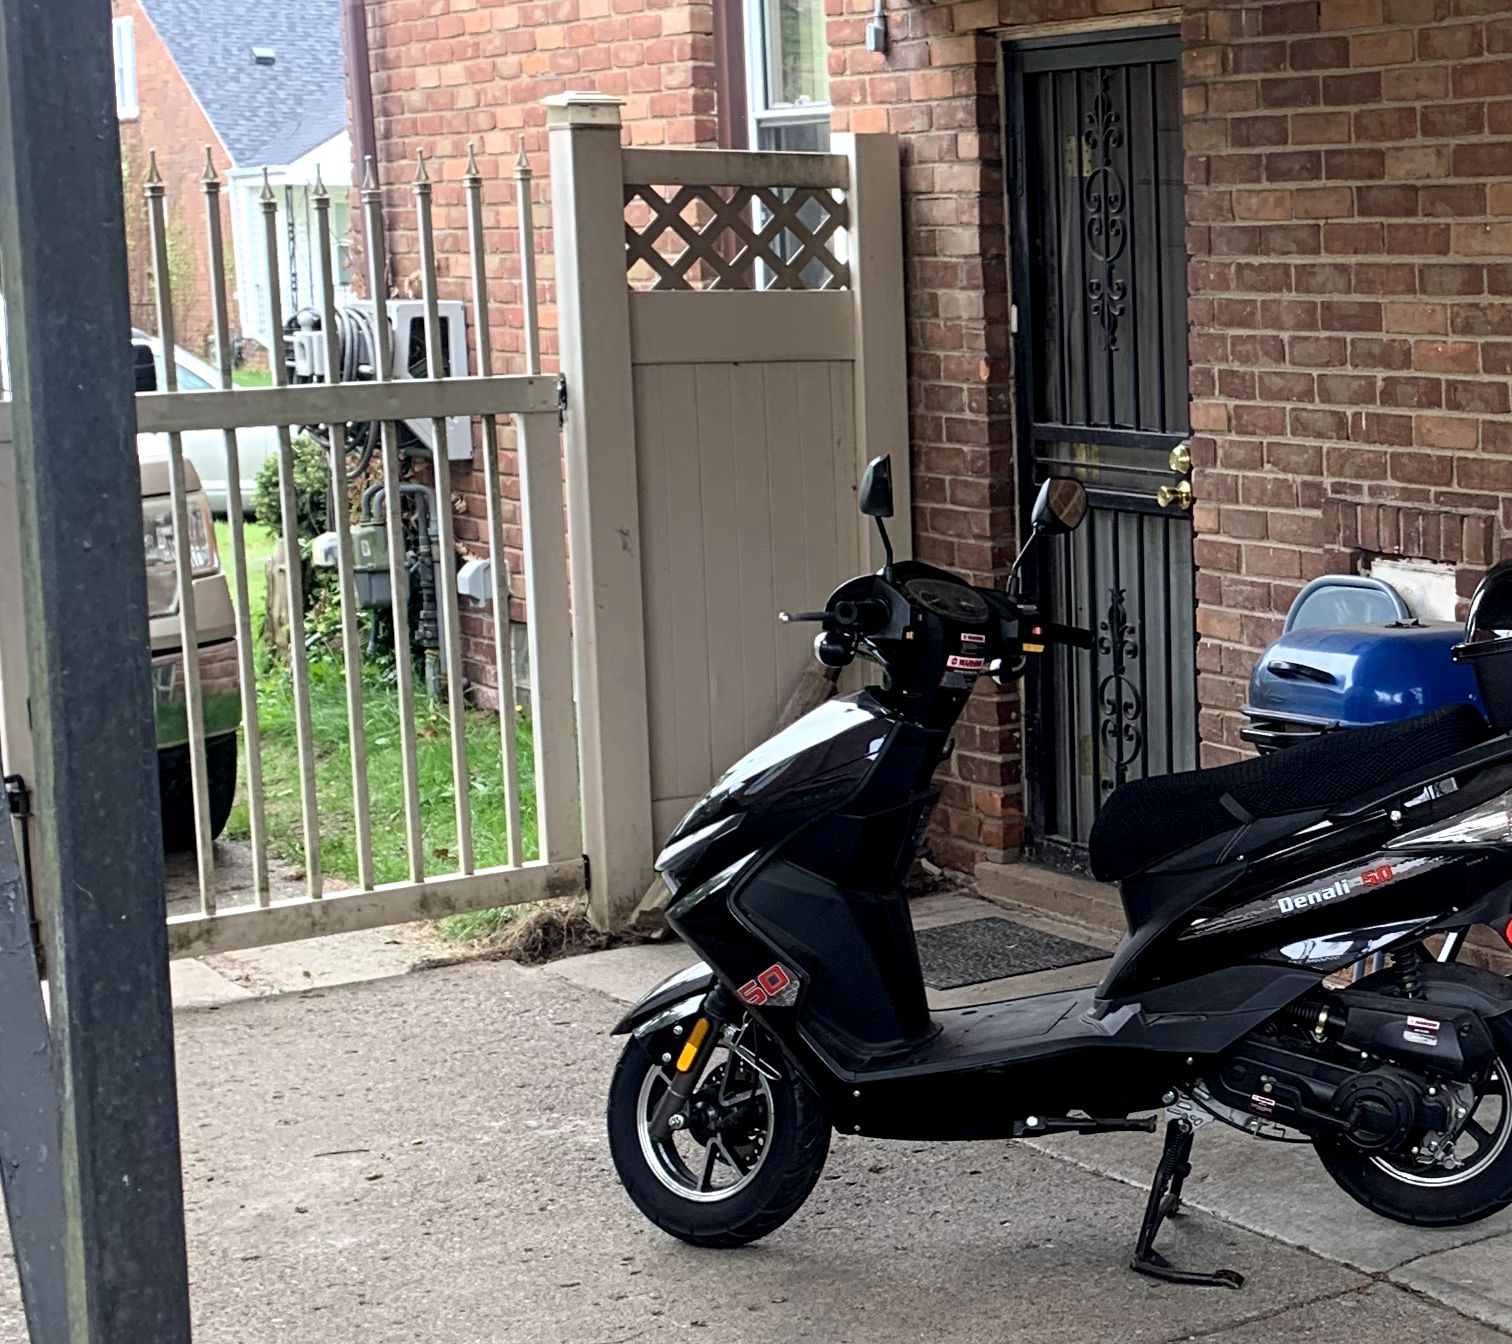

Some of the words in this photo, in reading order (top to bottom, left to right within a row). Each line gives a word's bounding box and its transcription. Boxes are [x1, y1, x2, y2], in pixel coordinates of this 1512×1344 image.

[1278, 879, 1350, 913] Denali
[1361, 864, 1392, 887] 50
[737, 964, 790, 1005] 50
